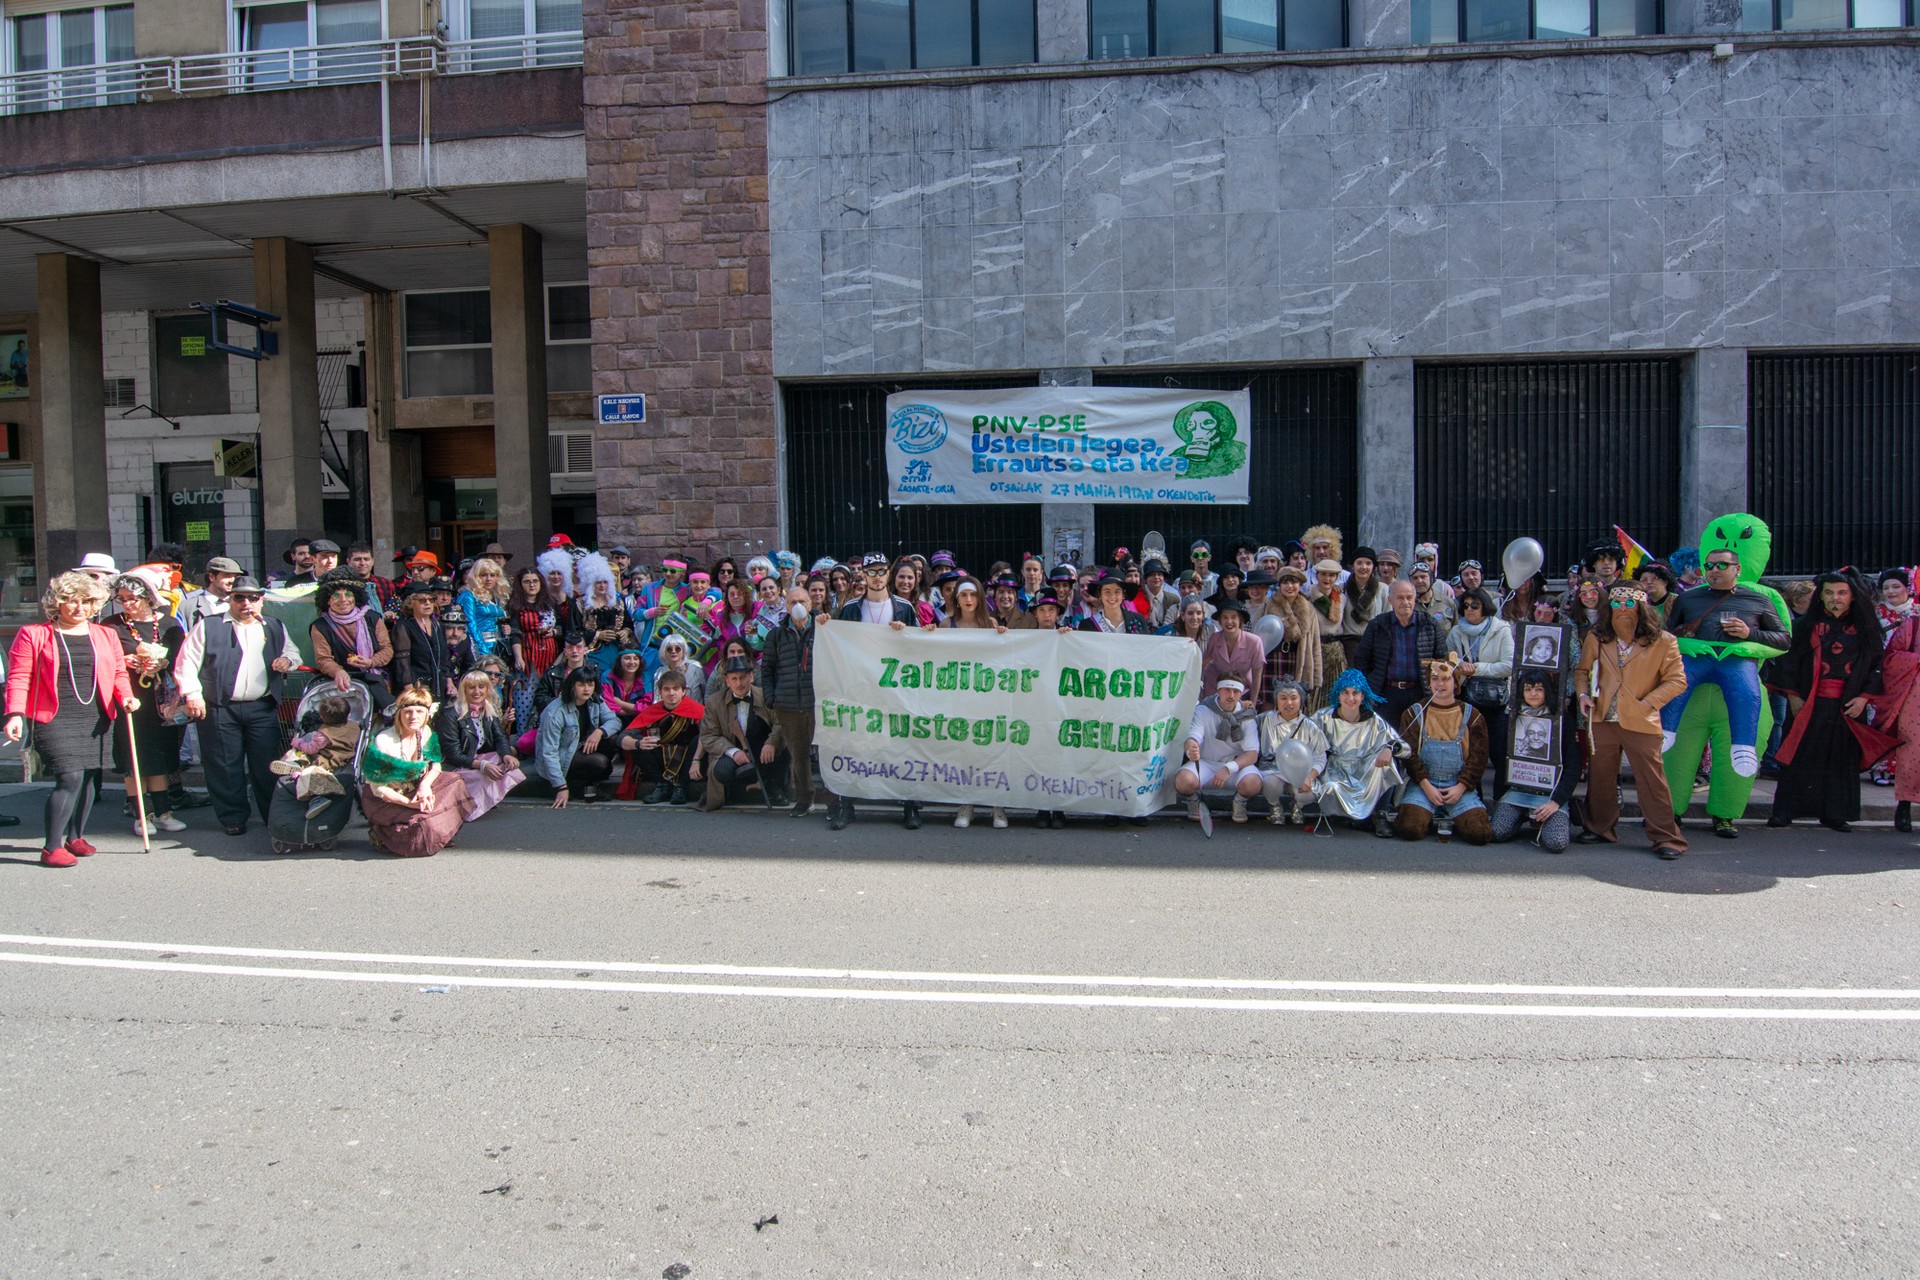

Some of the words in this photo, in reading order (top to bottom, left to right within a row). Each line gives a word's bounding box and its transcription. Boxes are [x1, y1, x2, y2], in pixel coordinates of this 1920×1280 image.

[972, 415, 1086, 433] PNV-PSE
[972, 433, 1075, 453] Ustelen
[1081, 433, 1164, 457] legea,
[226, 448, 252, 467] KELER
[972, 453, 1084, 473] Errautsa
[1090, 455, 1135, 472] eta
[1140, 452, 1189, 472] kea
[1051, 483, 1070, 496] 27
[879, 657, 1040, 693] Zaldibar
[1058, 667, 1186, 700] ARGITU
[822, 699, 1030, 746] Erraustegia
[1058, 717, 1181, 752] GELDITU
[901, 760, 929, 782] 27
